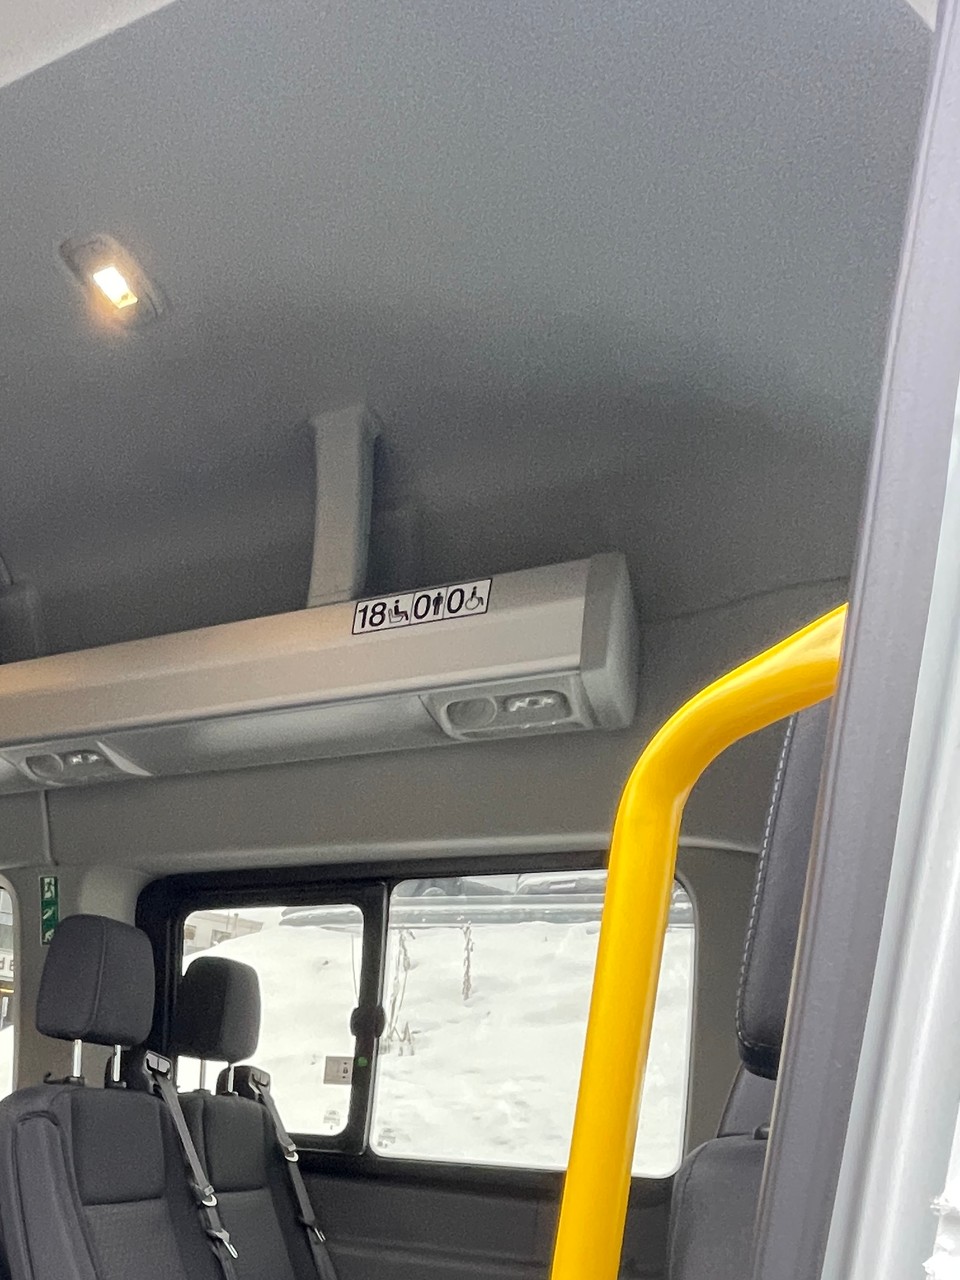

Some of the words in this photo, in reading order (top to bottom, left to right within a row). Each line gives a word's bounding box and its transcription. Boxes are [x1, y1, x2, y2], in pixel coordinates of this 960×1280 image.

[358, 602, 387, 628] 18
[413, 594, 431, 619] 0
[447, 588, 465, 613] 0
